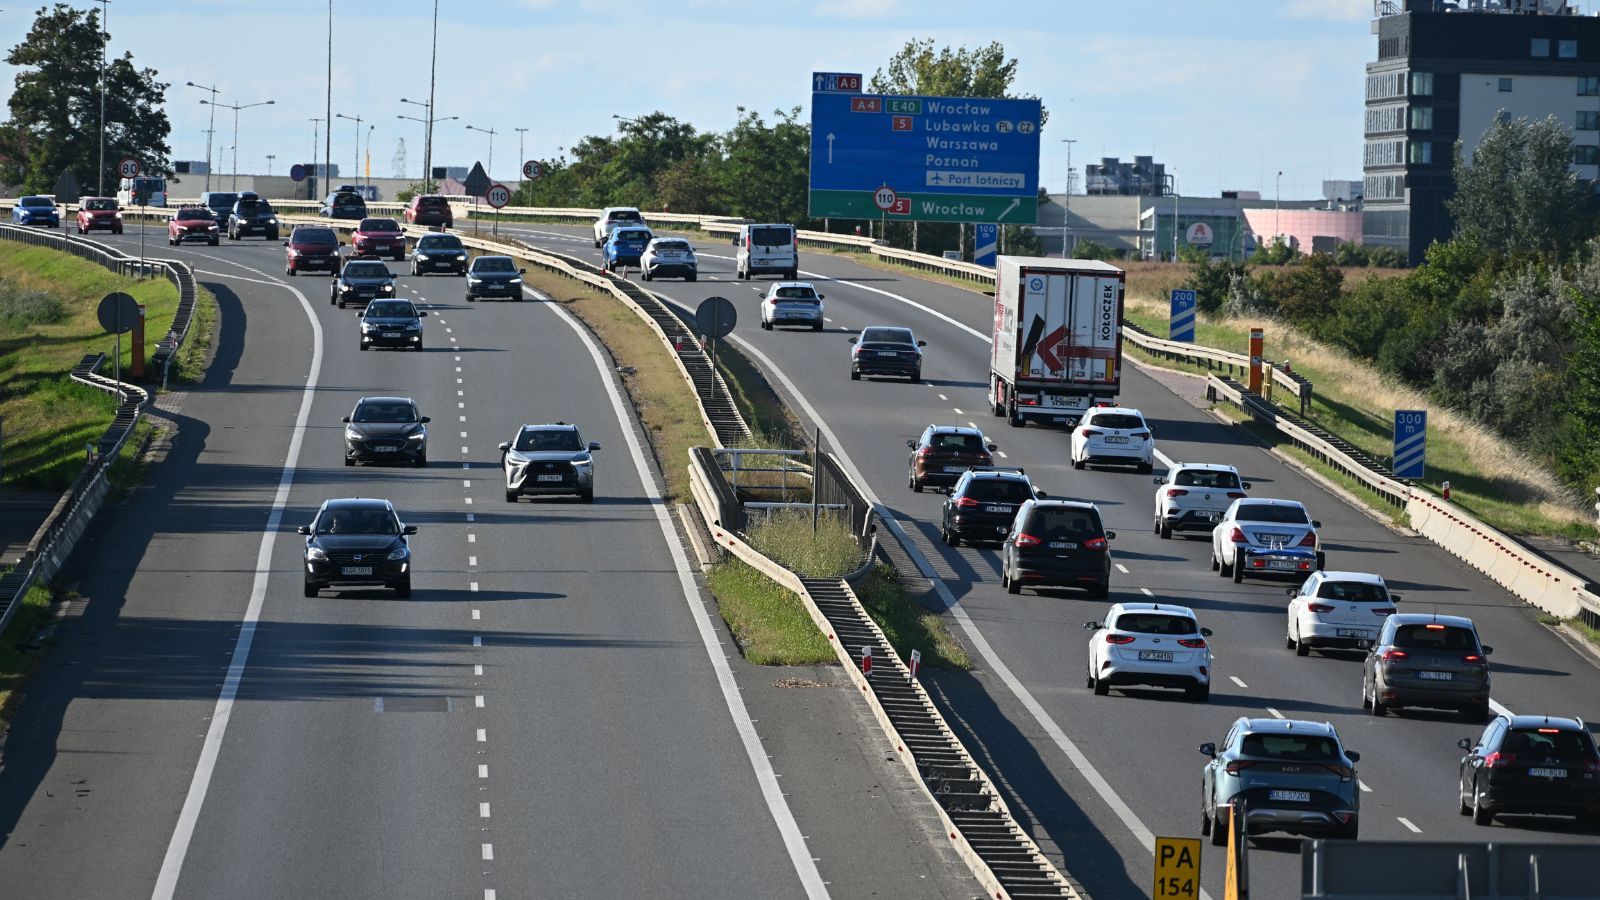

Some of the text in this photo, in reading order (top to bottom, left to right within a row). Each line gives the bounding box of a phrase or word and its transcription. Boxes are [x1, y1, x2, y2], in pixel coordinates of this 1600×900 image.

[857, 99, 991, 115] A4 E40 Wrocław
[899, 119, 906, 129] 5
[926, 119, 1031, 133] Lubawka PL CZ
[926, 136, 998, 151] Warszawa
[926, 154, 979, 168] Poznań
[122, 164, 138, 175] 80
[526, 164, 540, 174] 80
[948, 171, 1020, 187] Port lotniczy
[492, 193, 507, 202] 110
[878, 193, 893, 203] 110
[896, 200, 985, 216] 5 Wrocław
[980, 225, 994, 233] 100
[1174, 292, 1192, 301] 200
[1101, 285, 1113, 341] KOŁOCZEK
[1399, 413, 1422, 424] 300
[1405, 425, 1415, 433] m
[1160, 845, 1194, 869] PA
[1158, 878, 1194, 897] 154
